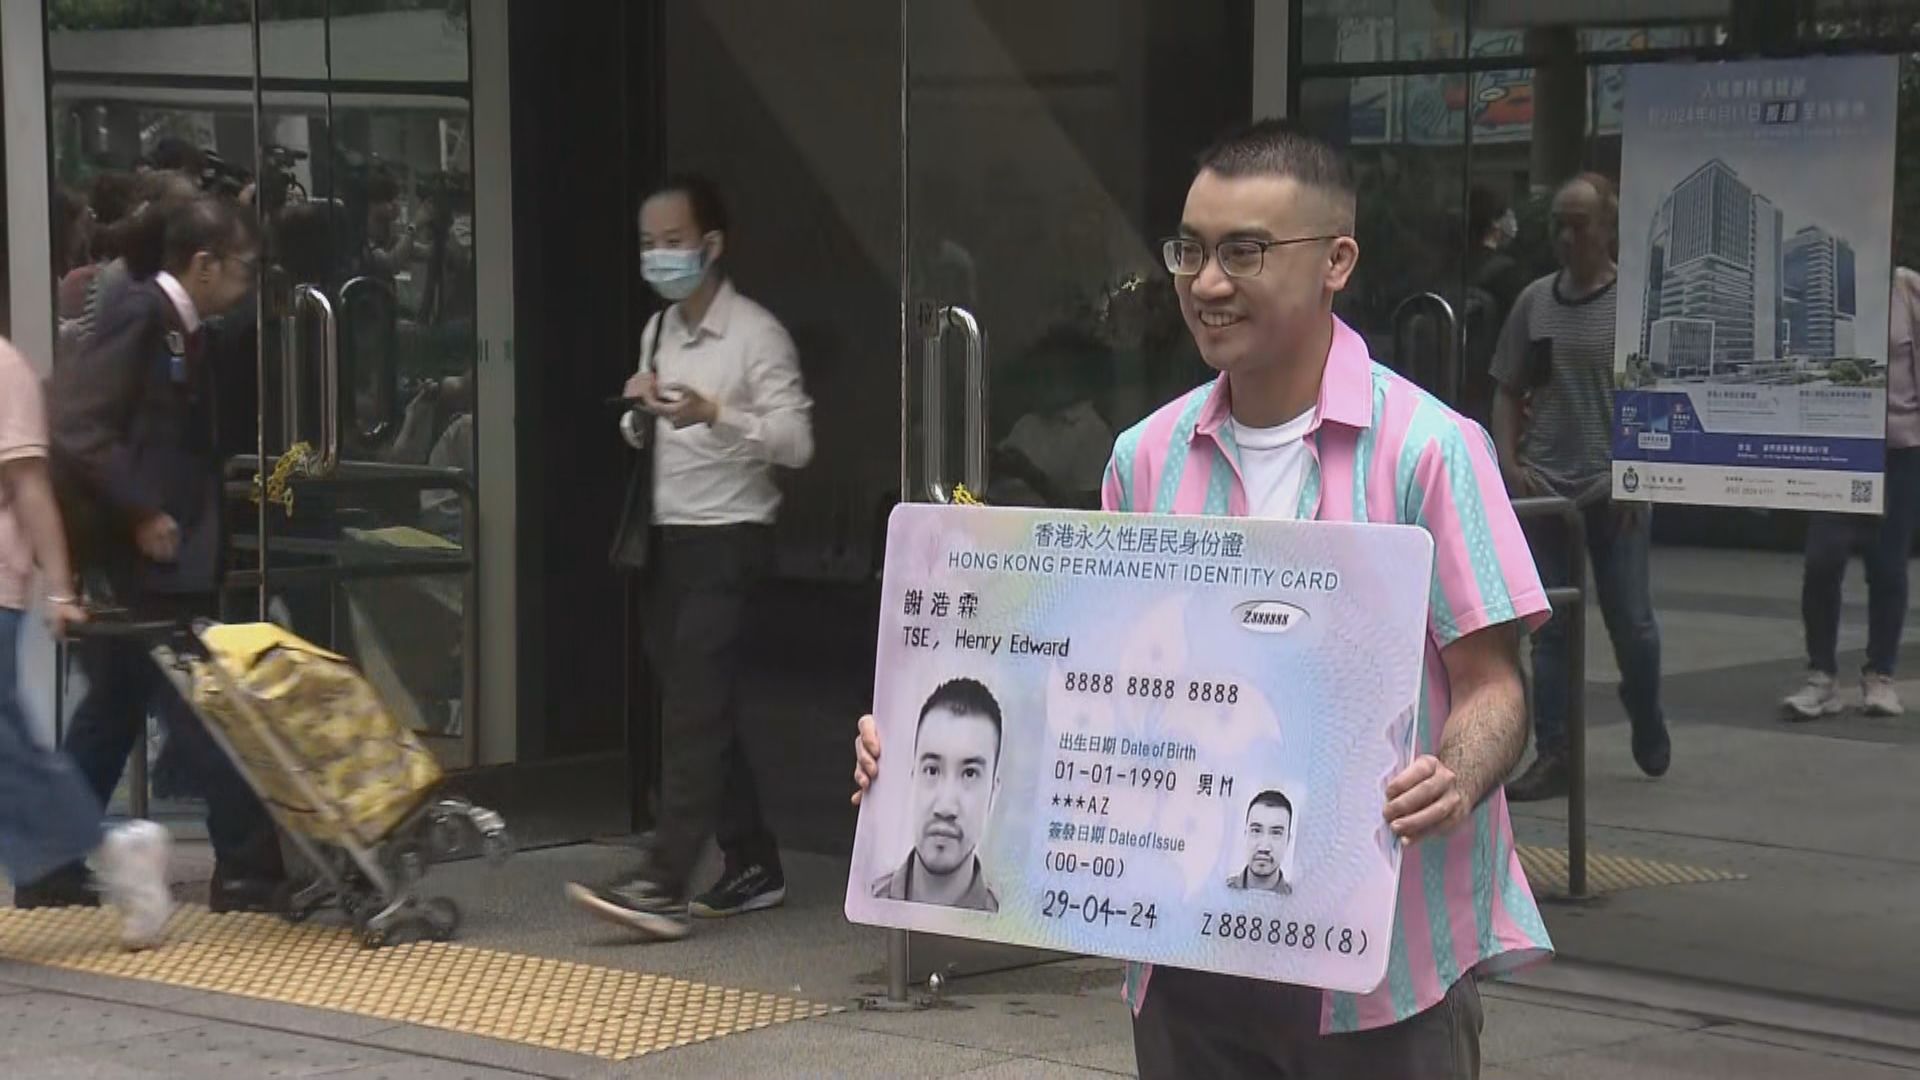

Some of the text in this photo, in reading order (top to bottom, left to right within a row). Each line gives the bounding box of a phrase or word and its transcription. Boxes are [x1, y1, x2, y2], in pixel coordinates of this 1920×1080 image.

[1035, 523, 1244, 558] 香港永久性居民身份證
[949, 552, 1338, 591] HONG KONG PERMANENT IDENTITY CARD
[903, 626, 1071, 657] TSE, Henry Edward
[1065, 672, 1238, 704] 8888 8888 8888
[1059, 732, 1197, 761] 出生日期 Date of Birth
[1055, 760, 1234, 797] 01-01-1990 男 M
[1048, 821, 1186, 852] 簽發日期 Date of Issue
[1045, 851, 1125, 879] (00-00)
[1042, 889, 1158, 929] 29-04-24
[1201, 912, 1368, 955] Z888888(8)
